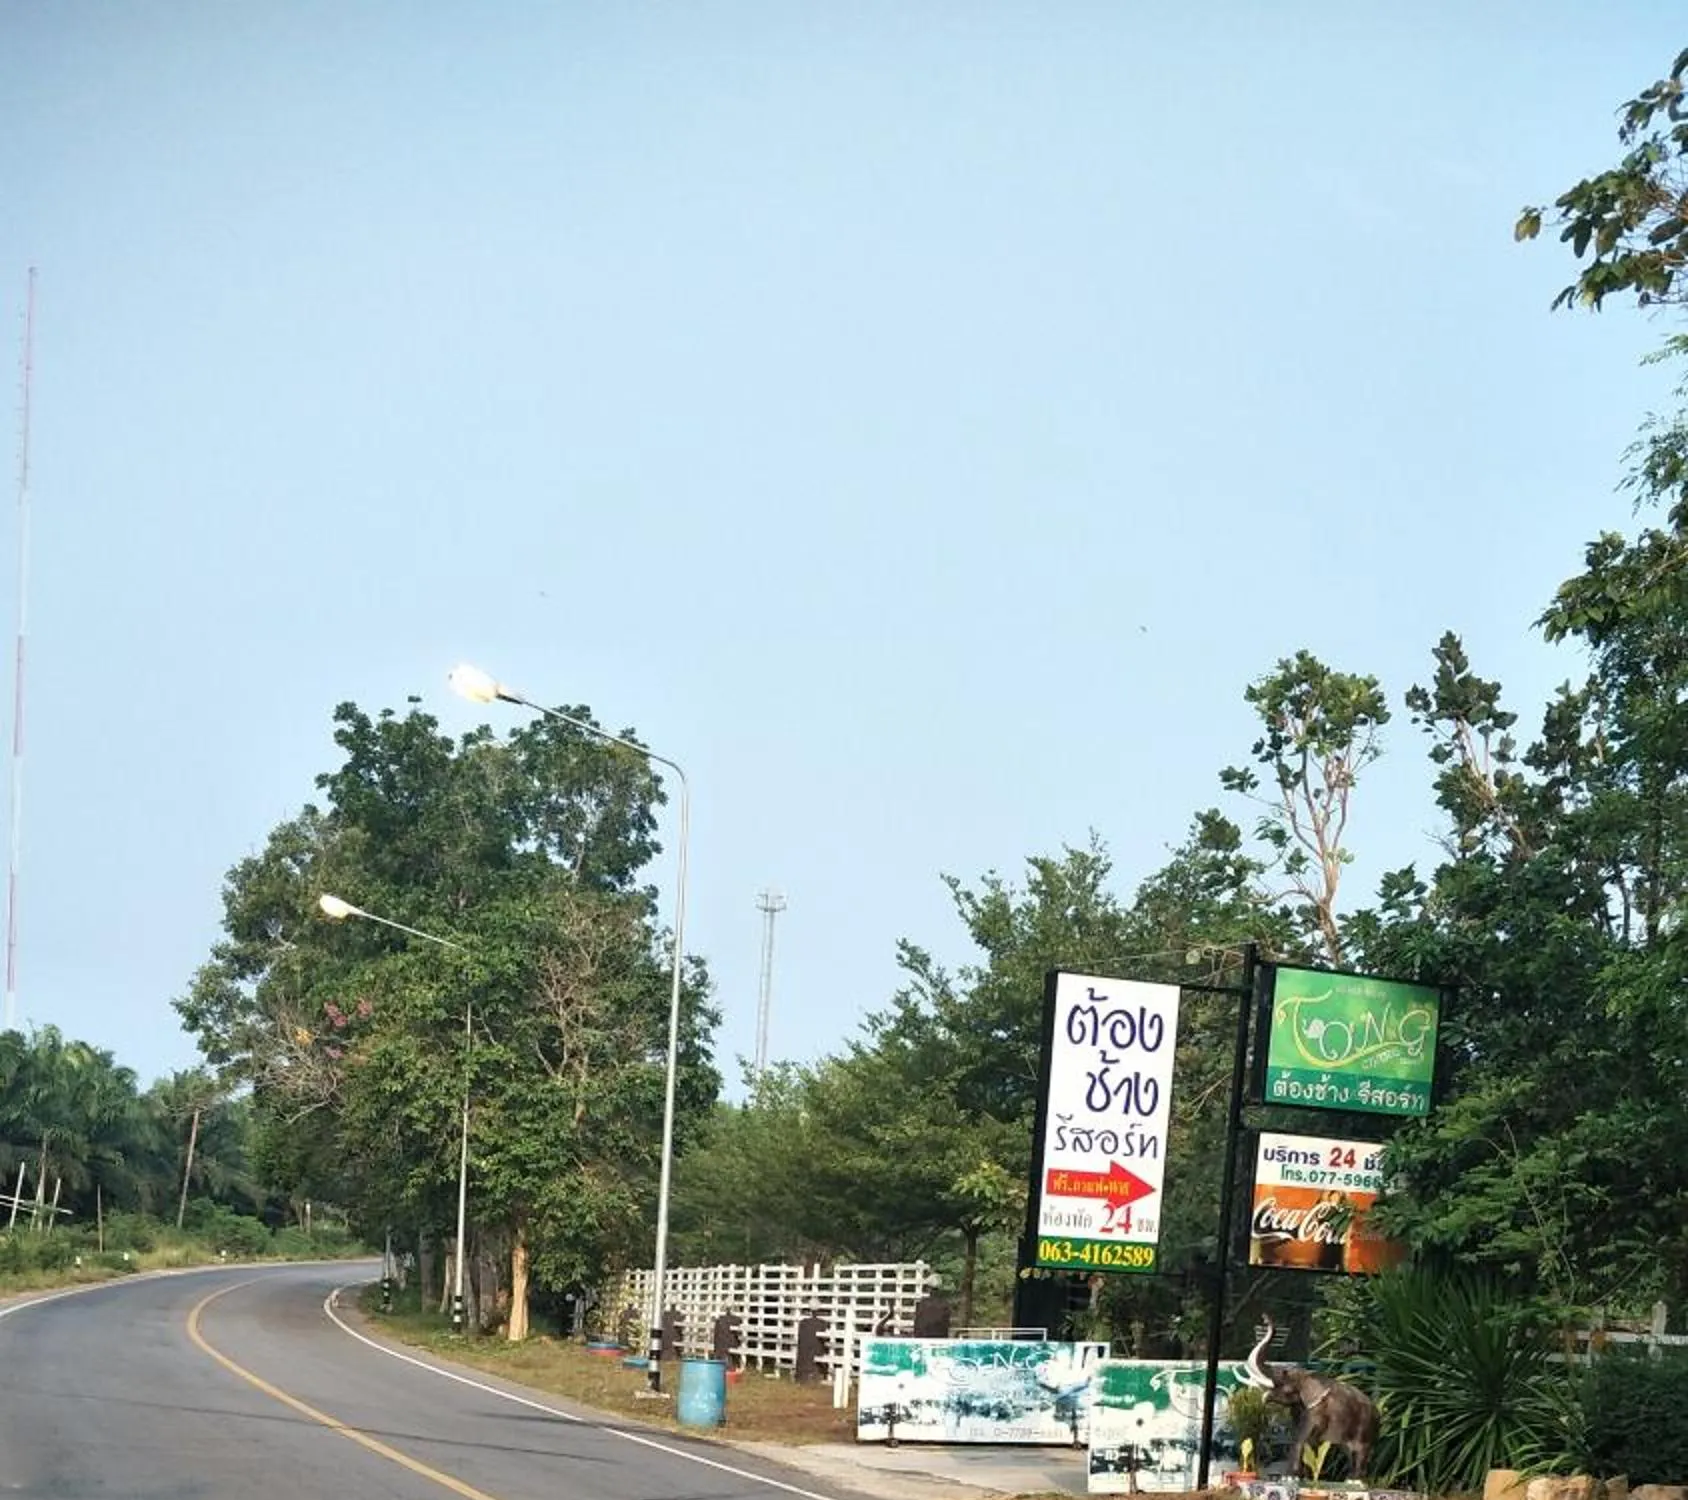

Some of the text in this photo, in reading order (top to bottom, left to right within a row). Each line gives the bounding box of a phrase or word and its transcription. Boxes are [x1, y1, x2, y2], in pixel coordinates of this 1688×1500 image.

[1067, 987, 1164, 1053] ต้อง
[1085, 1050, 1160, 1117] ช้าง
[1272, 1071, 1426, 1112] ต้องช้าง รีสอร์ท
[1055, 1113, 1159, 1159] รีสอร์ท
[1263, 1145, 1321, 1166] บริการ
[1329, 1146, 1357, 1169] 24
[1098, 1203, 1133, 1235] 24
[1038, 1239, 1155, 1267] 063-4162589
